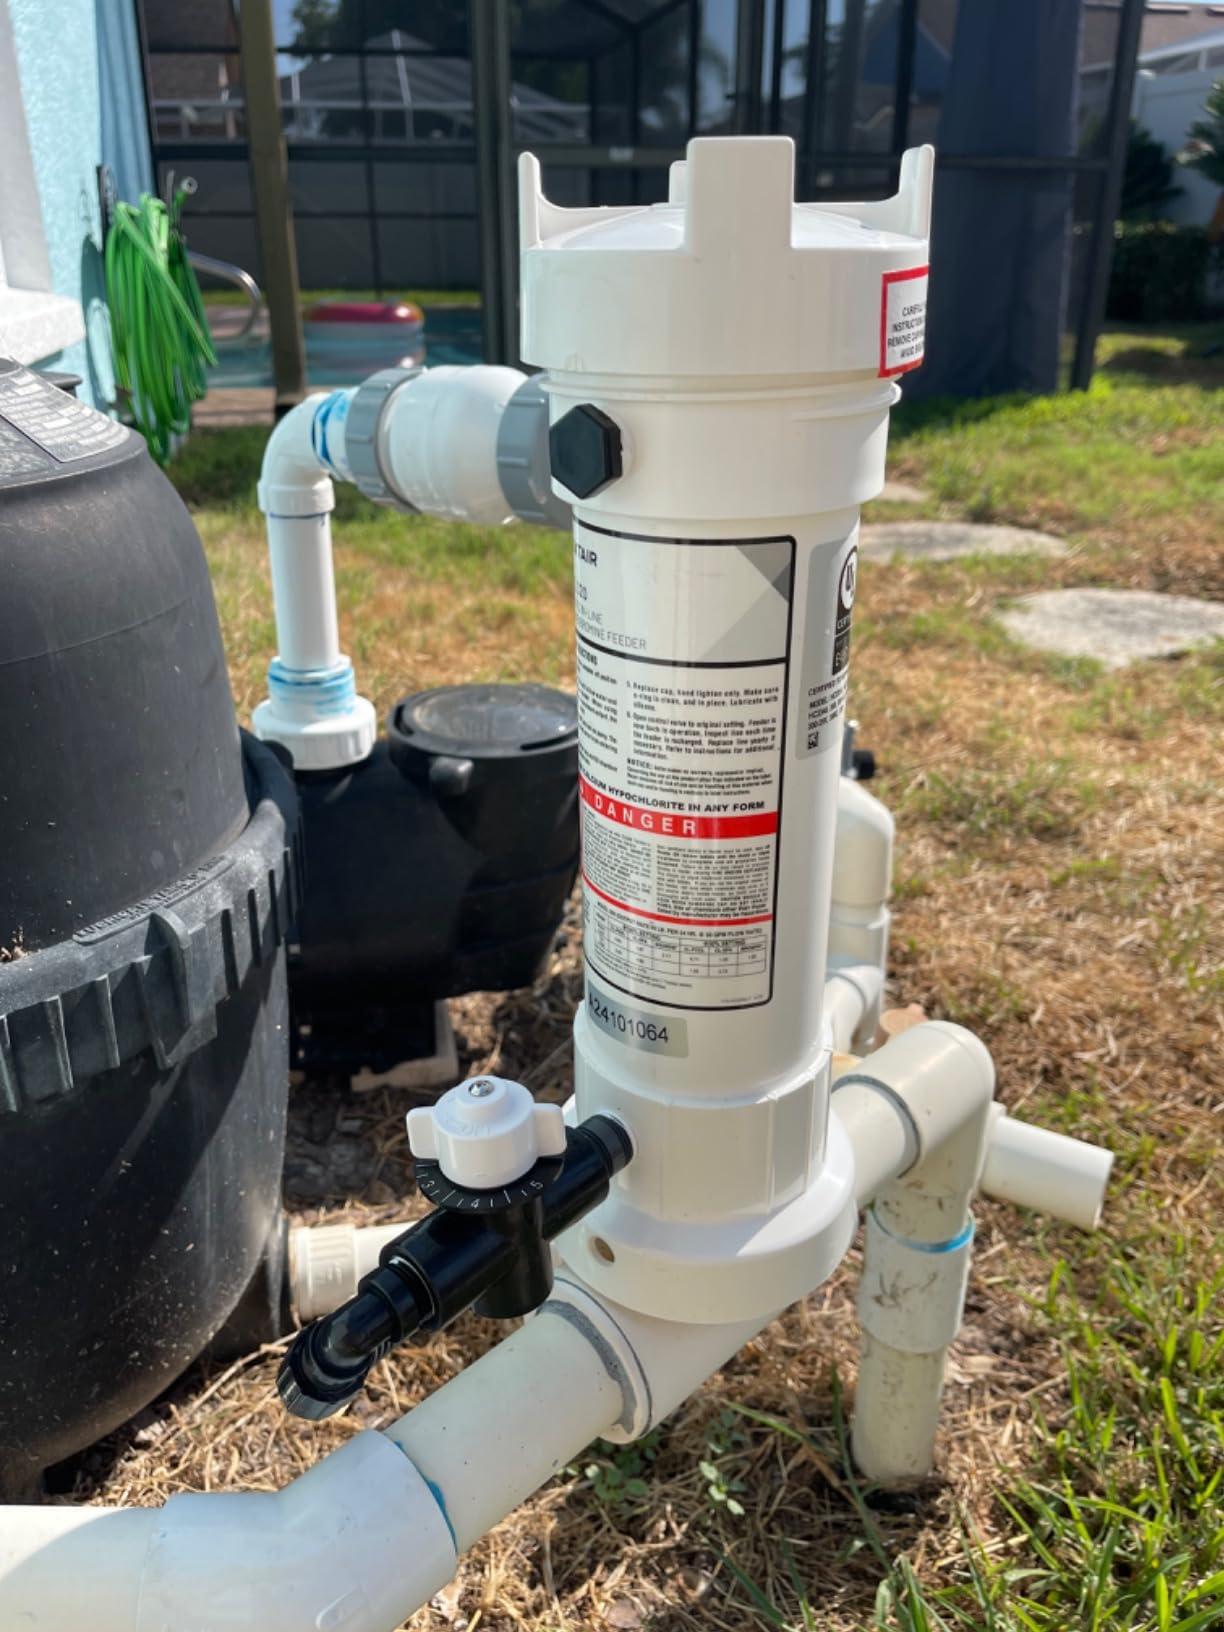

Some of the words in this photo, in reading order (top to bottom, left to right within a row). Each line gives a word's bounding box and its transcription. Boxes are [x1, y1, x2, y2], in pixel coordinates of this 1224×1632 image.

[576, 545, 598, 567] TAIR
[607, 631, 648, 650] FEEDER
[633, 683, 658, 693] Replace
[608, 785, 684, 811] HYPOCHLORITE
[688, 803, 701, 812] IN
[704, 804, 729, 812] ANY
[732, 801, 765, 812] FORM
[594, 794, 696, 834] DANGER
[530, 1180, 544, 1190] 5
[471, 1198, 481, 1209] 4
